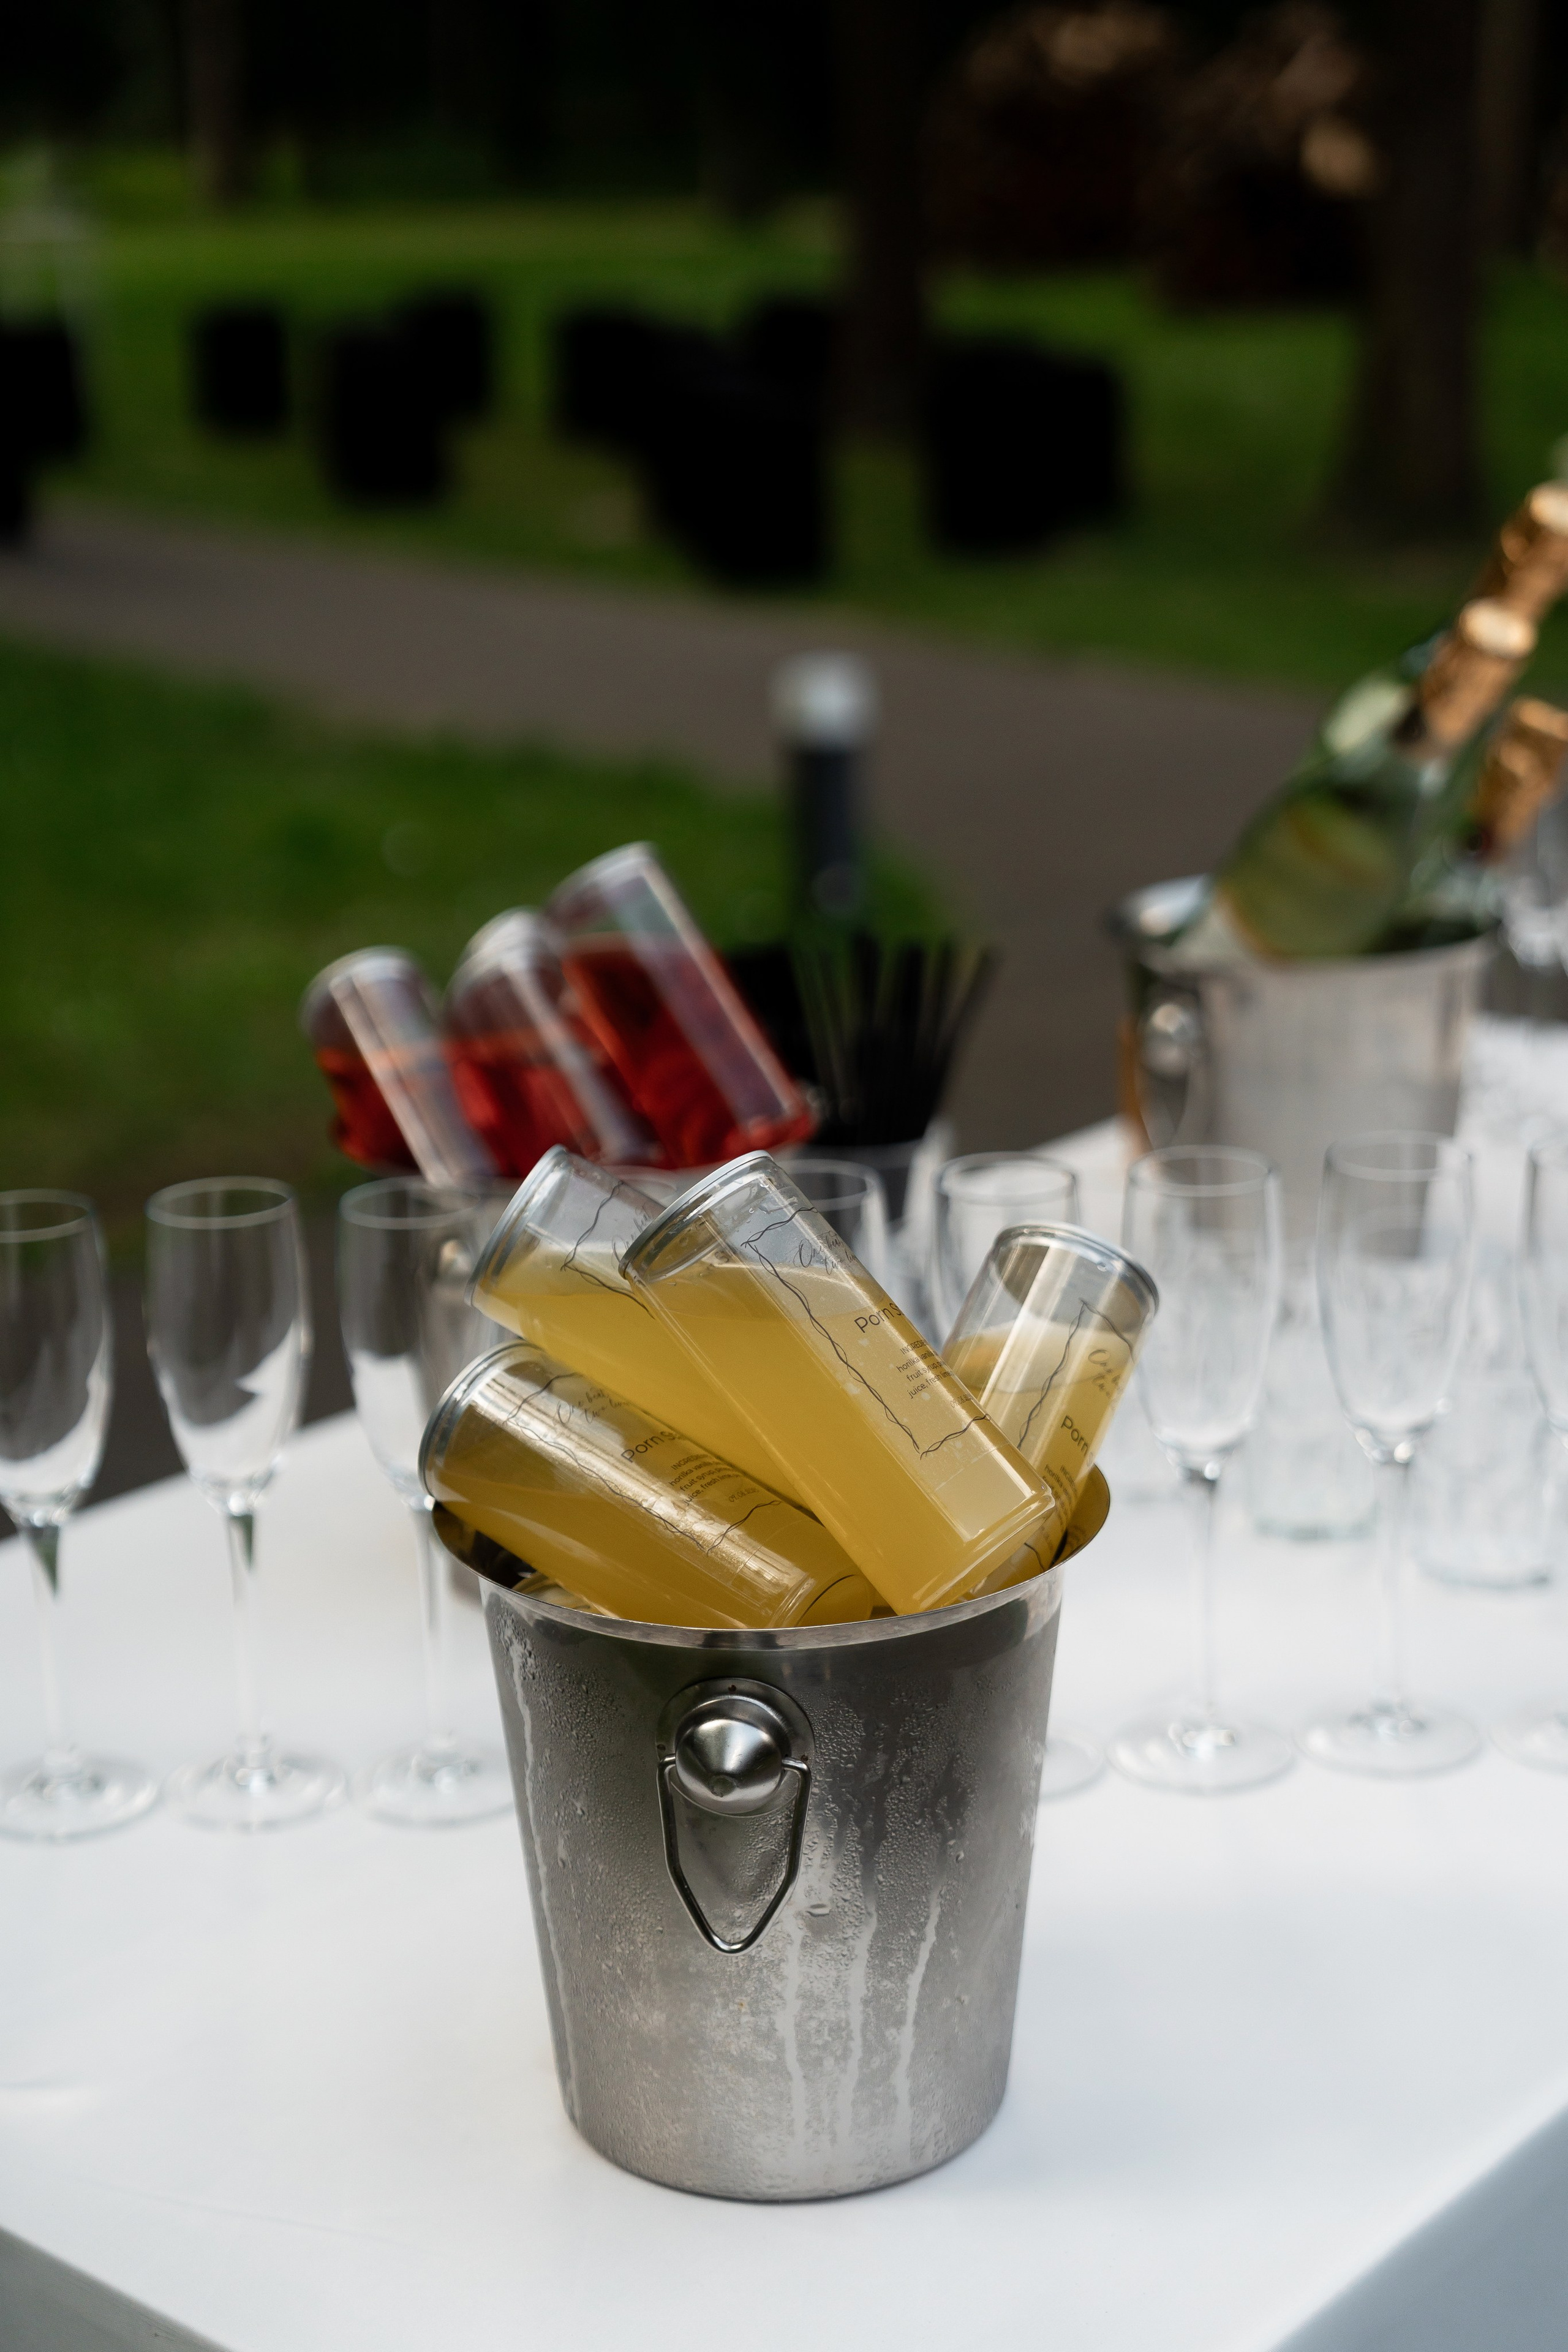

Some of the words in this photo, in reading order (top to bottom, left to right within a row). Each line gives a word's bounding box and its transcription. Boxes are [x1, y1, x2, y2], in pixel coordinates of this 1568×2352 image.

[854, 1308, 895, 1333] Porn
[896, 1356, 921, 1373] horilka
[907, 1370, 923, 1382] fruit
[907, 1383, 929, 1400] juice,
[925, 1373, 943, 1385] fresh
[1061, 1415, 1088, 1457] Porn
[620, 1436, 665, 1463] Porn
[668, 1468, 694, 1487] horilka
[679, 1478, 697, 1492] fruit
[700, 1476, 720, 1490] fresh
